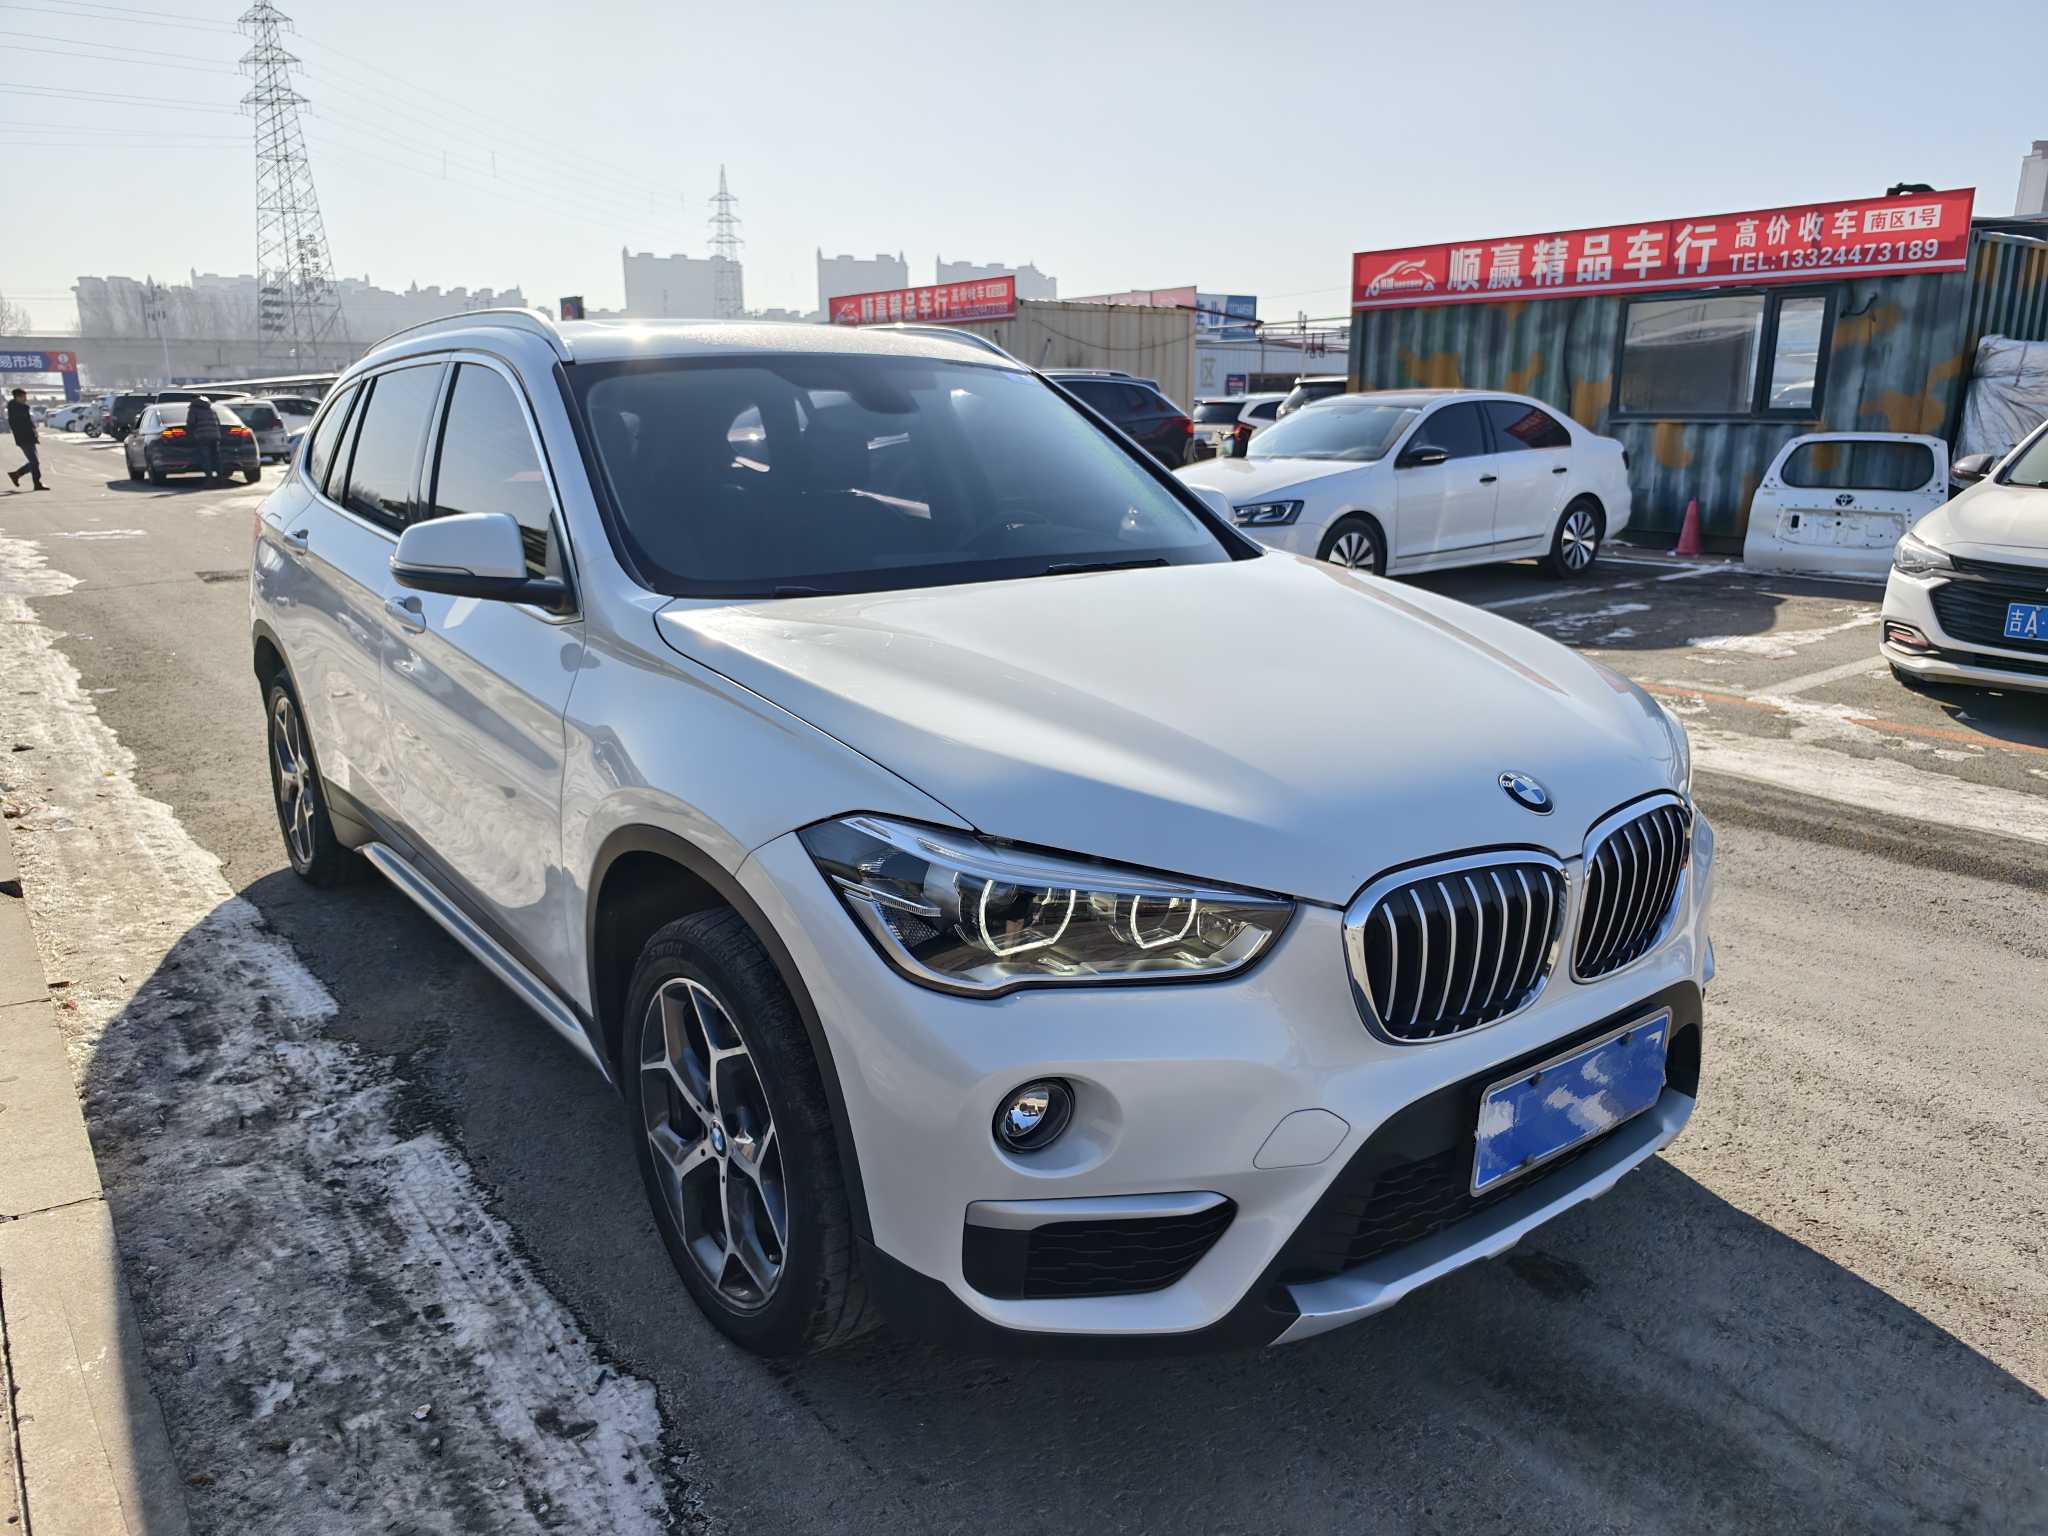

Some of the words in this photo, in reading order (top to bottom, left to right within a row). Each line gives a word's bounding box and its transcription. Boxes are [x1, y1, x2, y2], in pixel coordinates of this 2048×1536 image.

[1735, 209, 1858, 248] 高价收车
[1870, 207, 1937, 230] 南区1号
[1447, 224, 1718, 290] 顺赢精品车行
[1729, 239, 1939, 273] TEL:13324473189
